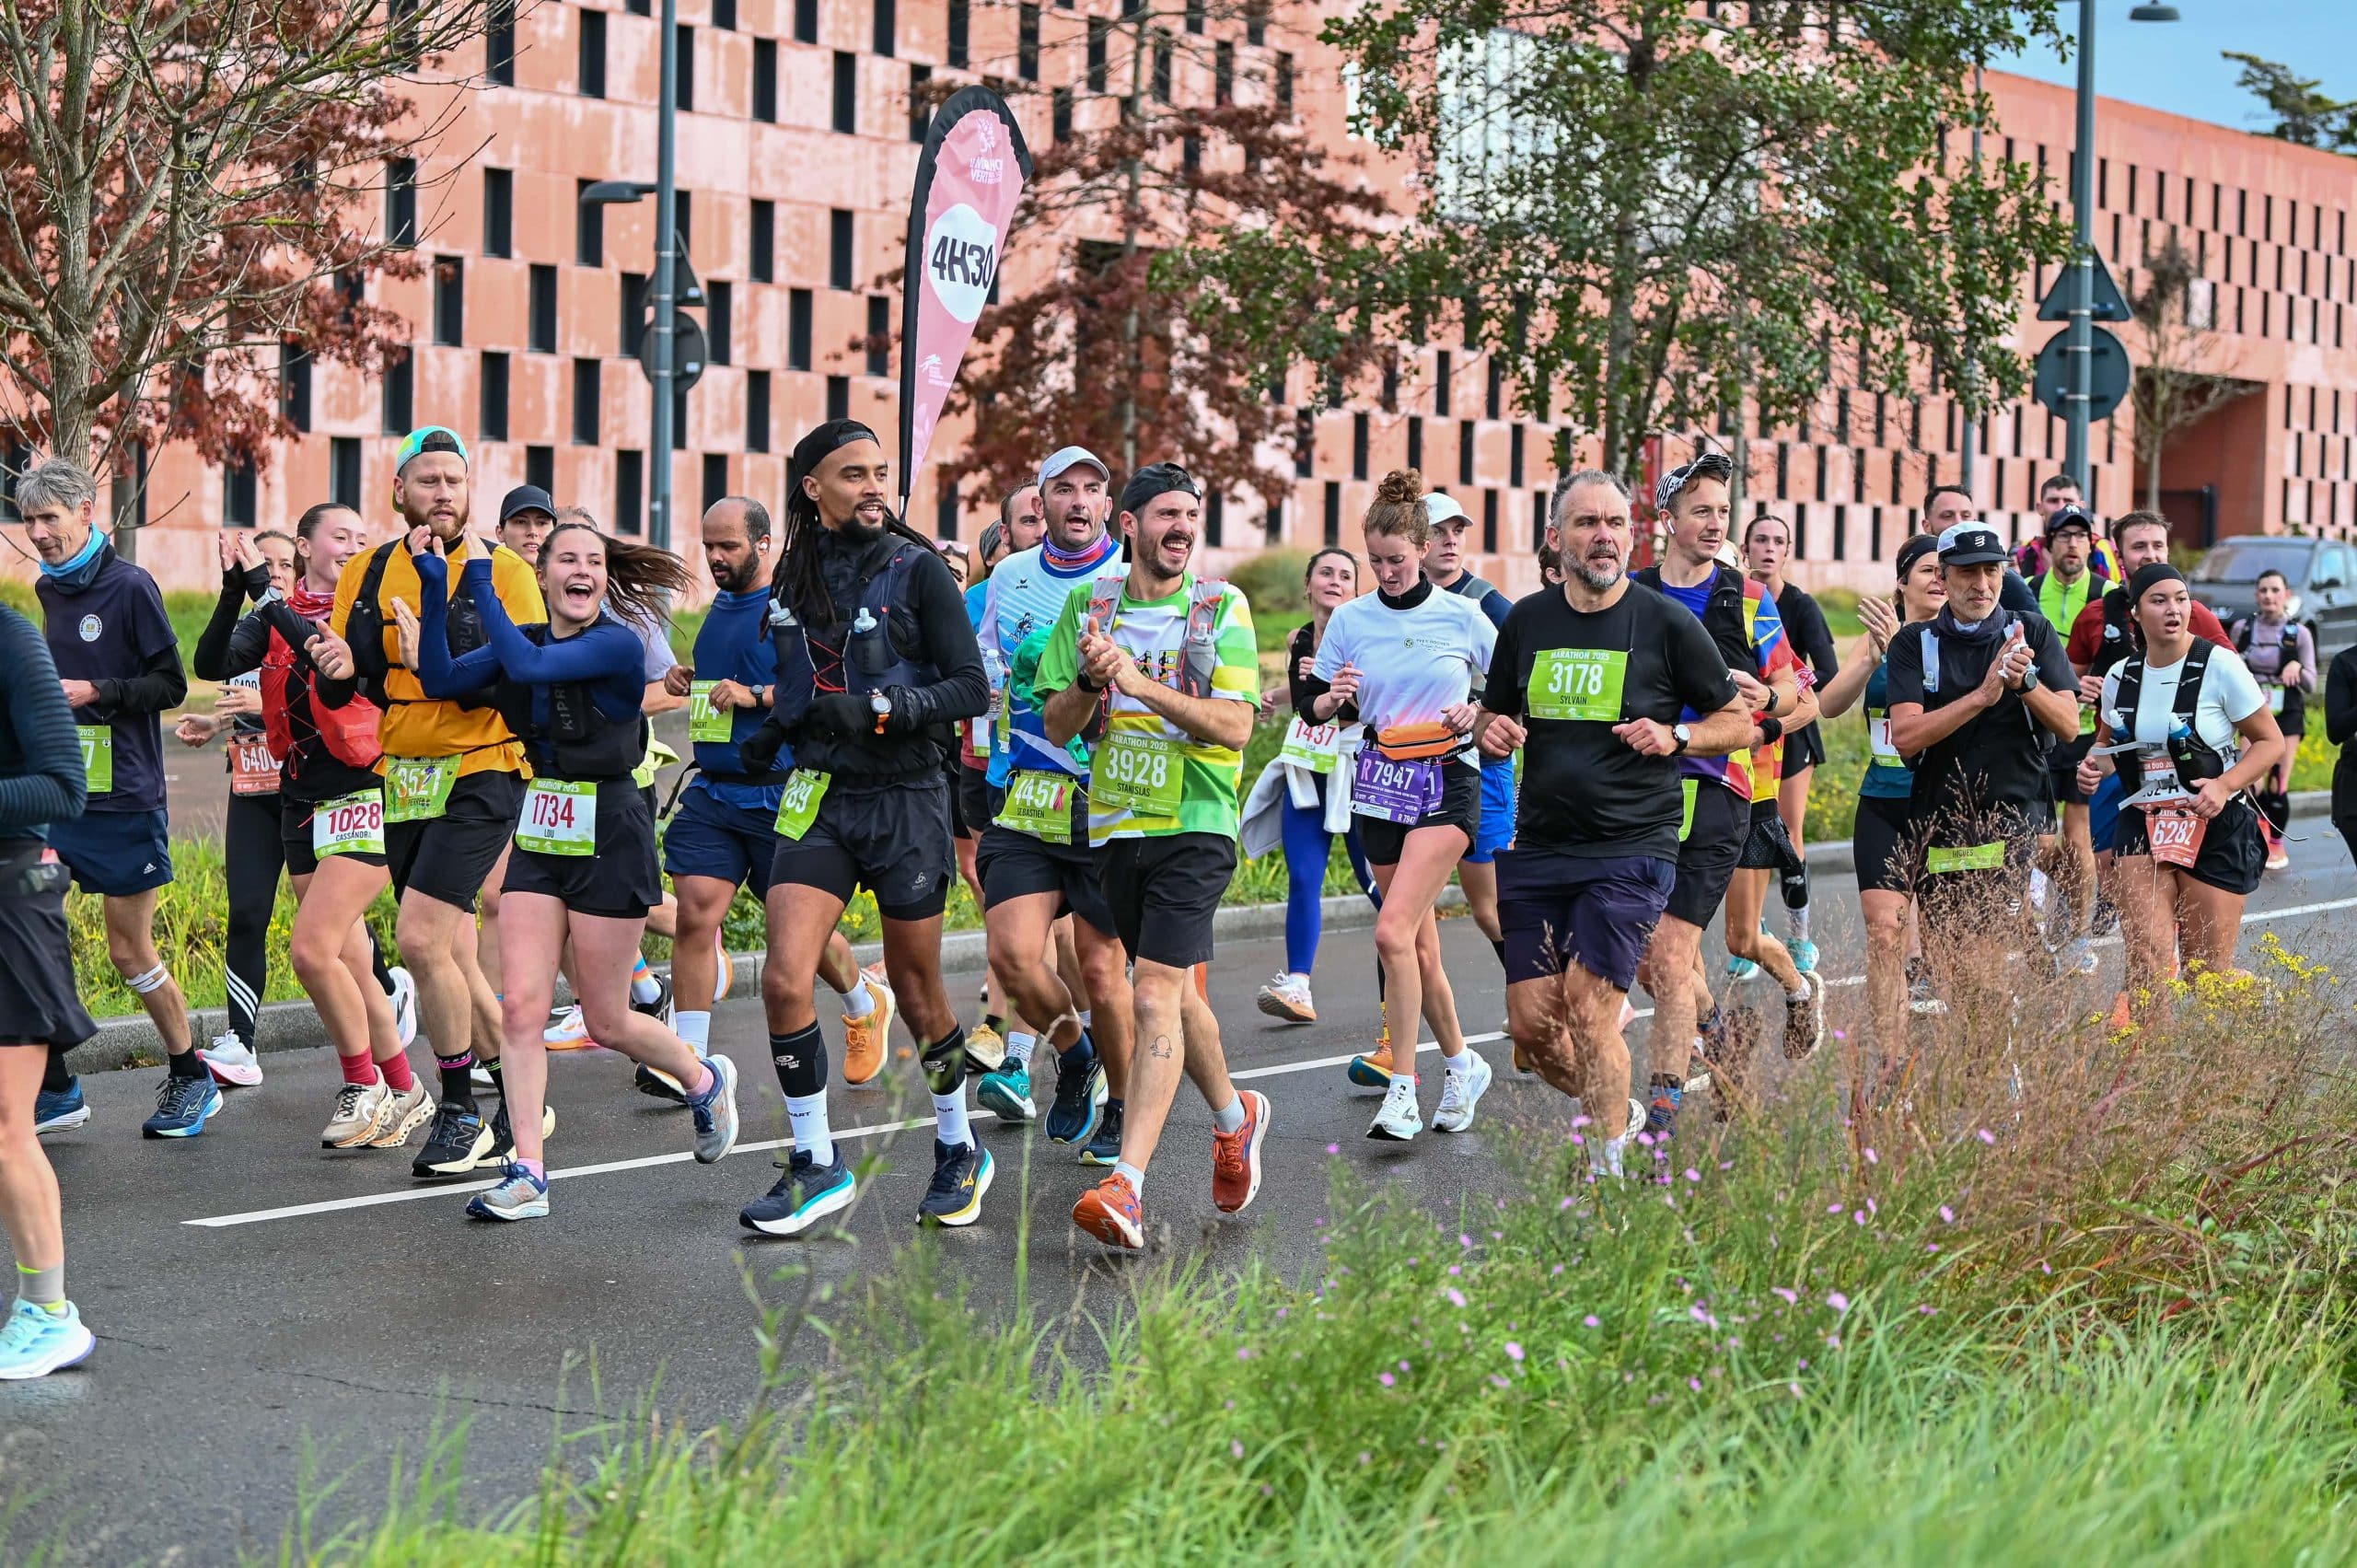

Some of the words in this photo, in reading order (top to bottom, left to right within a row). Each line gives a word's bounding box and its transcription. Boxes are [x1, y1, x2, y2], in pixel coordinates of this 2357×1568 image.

[932, 235, 993, 290] 4H30
[1550, 650, 1590, 660] MARATHON
[1548, 661, 1604, 696] 3178
[1560, 694, 1587, 705] SYLVAIN
[1109, 734, 1148, 749] MARATHON
[1149, 740, 1169, 751] 2025
[1295, 719, 1337, 747] 1437
[398, 766, 443, 798] 3521
[1105, 746, 1167, 789] 3928
[1360, 758, 1373, 783] R
[1372, 761, 1415, 791] 7947
[1015, 778, 1060, 809] 4451
[1117, 783, 1151, 797] STANISLAS
[329, 802, 381, 835] 1028
[532, 793, 575, 829] 1734
[335, 830, 372, 842] CASSANDRA
[544, 828, 555, 839] LOU
[2153, 819, 2198, 846] 6282
